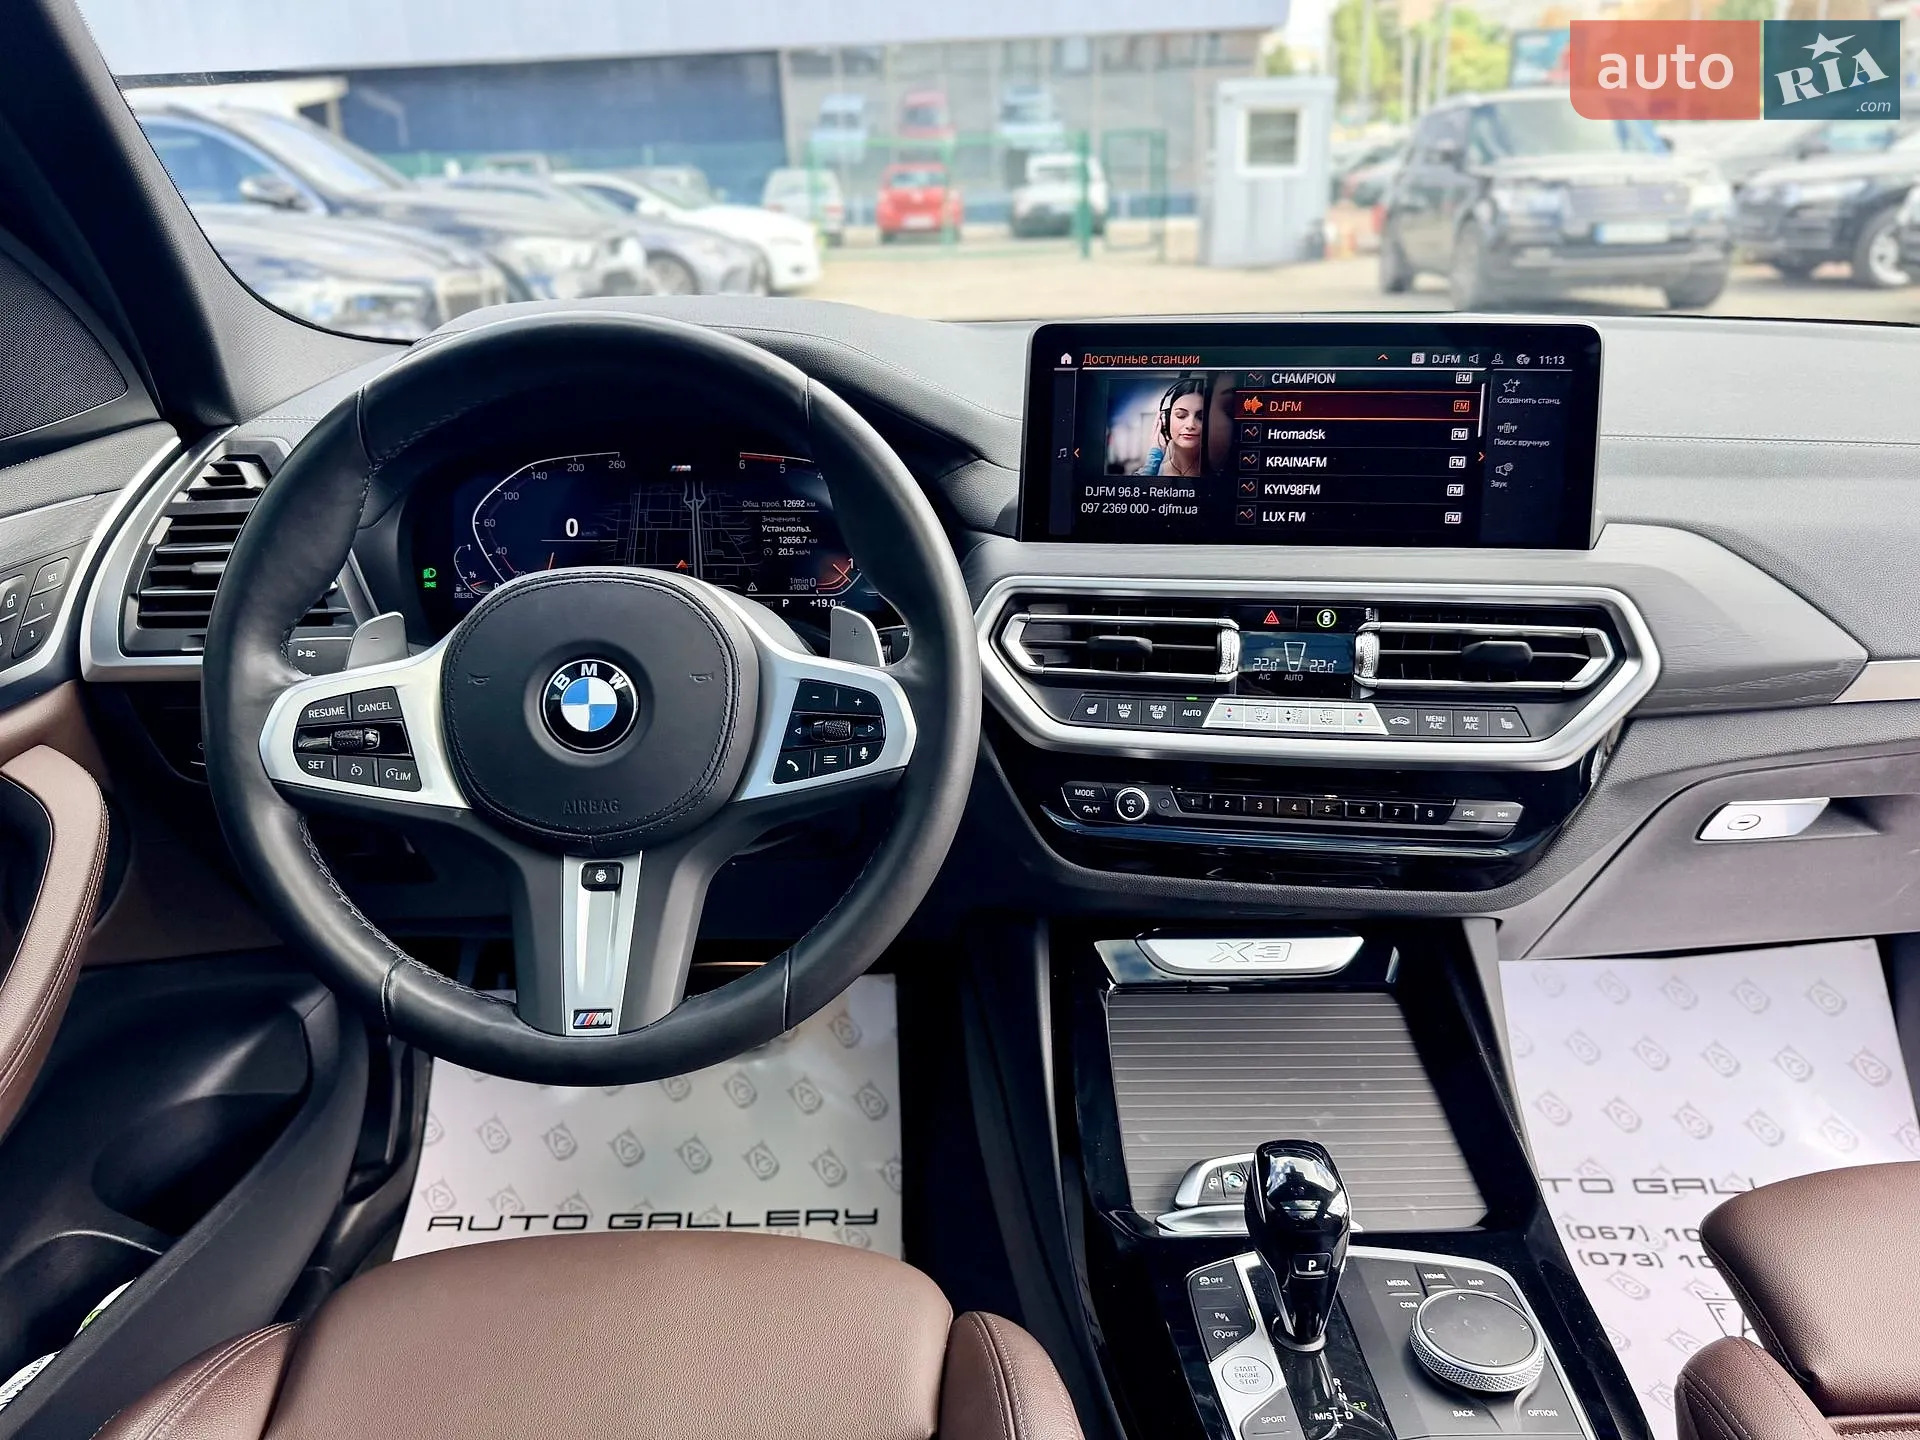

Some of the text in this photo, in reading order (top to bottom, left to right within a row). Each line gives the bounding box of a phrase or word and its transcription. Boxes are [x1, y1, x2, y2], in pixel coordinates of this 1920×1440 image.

[1082, 353, 1200, 367] Доступные станции
[1431, 354, 1460, 364] DJFM
[1538, 355, 1565, 365] 11:13
[1271, 372, 1471, 384] CHAMPION FM
[1497, 396, 1536, 405] Сохранить
[1269, 401, 1468, 412] DJFM FM
[1267, 428, 1466, 440] Hromadsk FM
[1493, 438, 1517, 446] Поиск
[608, 460, 626, 470] 260
[739, 459, 746, 470] 6
[1266, 456, 1464, 468] KRAINAFM FM
[567, 463, 585, 473] 200
[779, 464, 786, 474] 5
[531, 471, 548, 481] 140
[1264, 484, 1462, 495] KYIV98FM FM
[1490, 480, 1508, 489] Звук
[503, 491, 519, 501] 100
[1085, 486, 1116, 498] DJFM
[1118, 486, 1140, 498] 96.8
[1149, 486, 1196, 498] Reklama
[783, 500, 805, 508] 12692
[1080, 502, 1100, 514] 097
[1102, 502, 1127, 514] 2369
[1130, 502, 1149, 514] 000
[1158, 503, 1198, 517] djfm.ua
[1262, 511, 1460, 523] LUX FM FM
[483, 518, 496, 528] 60
[565, 518, 579, 538] 0
[495, 546, 507, 556] 40
[778, 548, 794, 556] 20.5
[782, 599, 789, 608] P
[553, 662, 629, 691] BMW
[1258, 673, 1303, 682] A/C AUTO
[308, 701, 393, 719] RESUME CANCEL
[1117, 703, 1132, 711] MAX
[1149, 704, 1167, 712] REAR
[1182, 709, 1201, 717] AUTO
[1425, 715, 1446, 723] MENU
[1463, 715, 1479, 723] MAX
[1429, 722, 1443, 730] A/C
[1465, 722, 1479, 730] A/C
[308, 760, 411, 781] SET LIM
[1074, 788, 1095, 797] MODE
[562, 799, 621, 815] AIRBAG
[1291, 803, 1297, 811] 4
[1324, 805, 1331, 813] 5
[1359, 807, 1366, 815] 6
[1209, 941, 1292, 963] X3
[1540, 1177, 1614, 1194] TO
[427, 1207, 878, 1232] AUTO GALLERY
[1565, 1223, 1649, 1242] (067)
[1577, 1249, 1664, 1269] (073)
[1308, 1259, 1317, 1271] P
[1210, 1276, 1224, 1284] OFF
[1386, 1279, 1411, 1287] MEDIA
[1399, 1301, 1418, 1309] COM
[1333, 1378, 1341, 1386] R
[1260, 1415, 1287, 1424] SPORT
[1345, 1411, 1354, 1420] D
